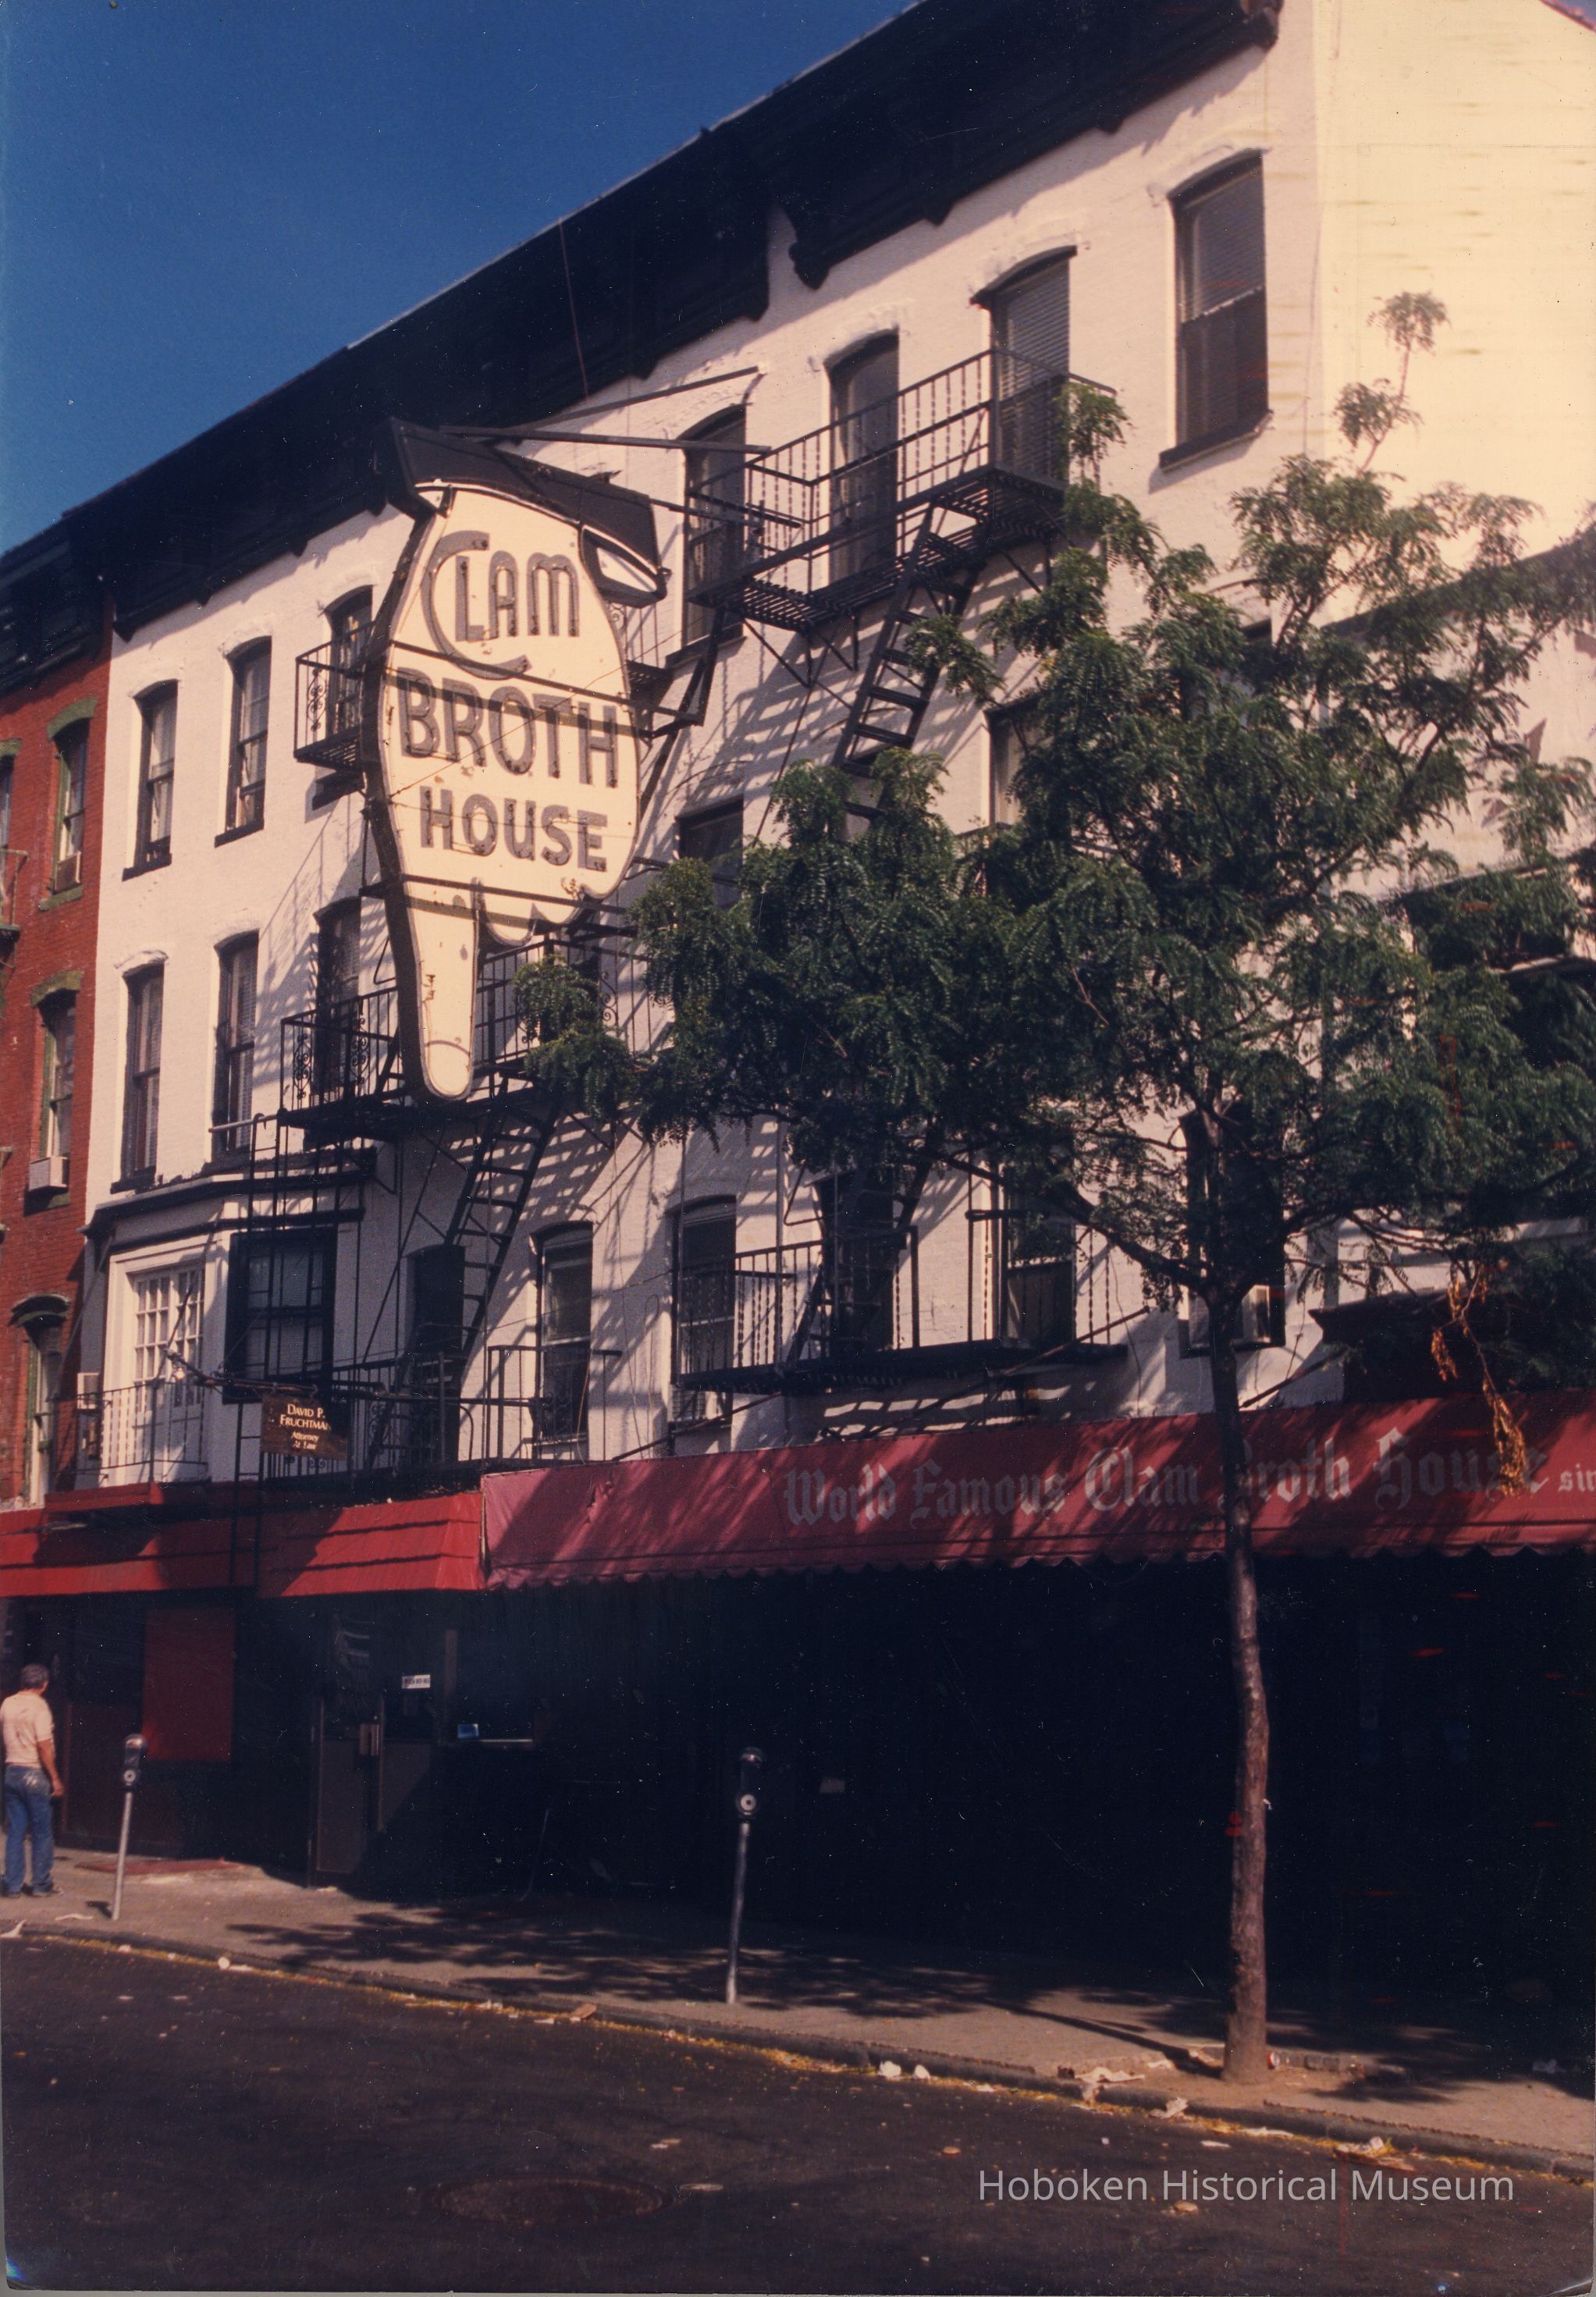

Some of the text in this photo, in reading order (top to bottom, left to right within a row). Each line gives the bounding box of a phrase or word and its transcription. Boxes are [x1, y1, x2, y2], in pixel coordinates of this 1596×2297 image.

[396, 666, 618, 788] BROTH
[419, 786, 608, 873] HOUSE
[292, 1431, 319, 1442] Attorney
[784, 1463, 896, 1526] World
[910, 1460, 1065, 1529] Famous
[1085, 1446, 1200, 1511] Clam
